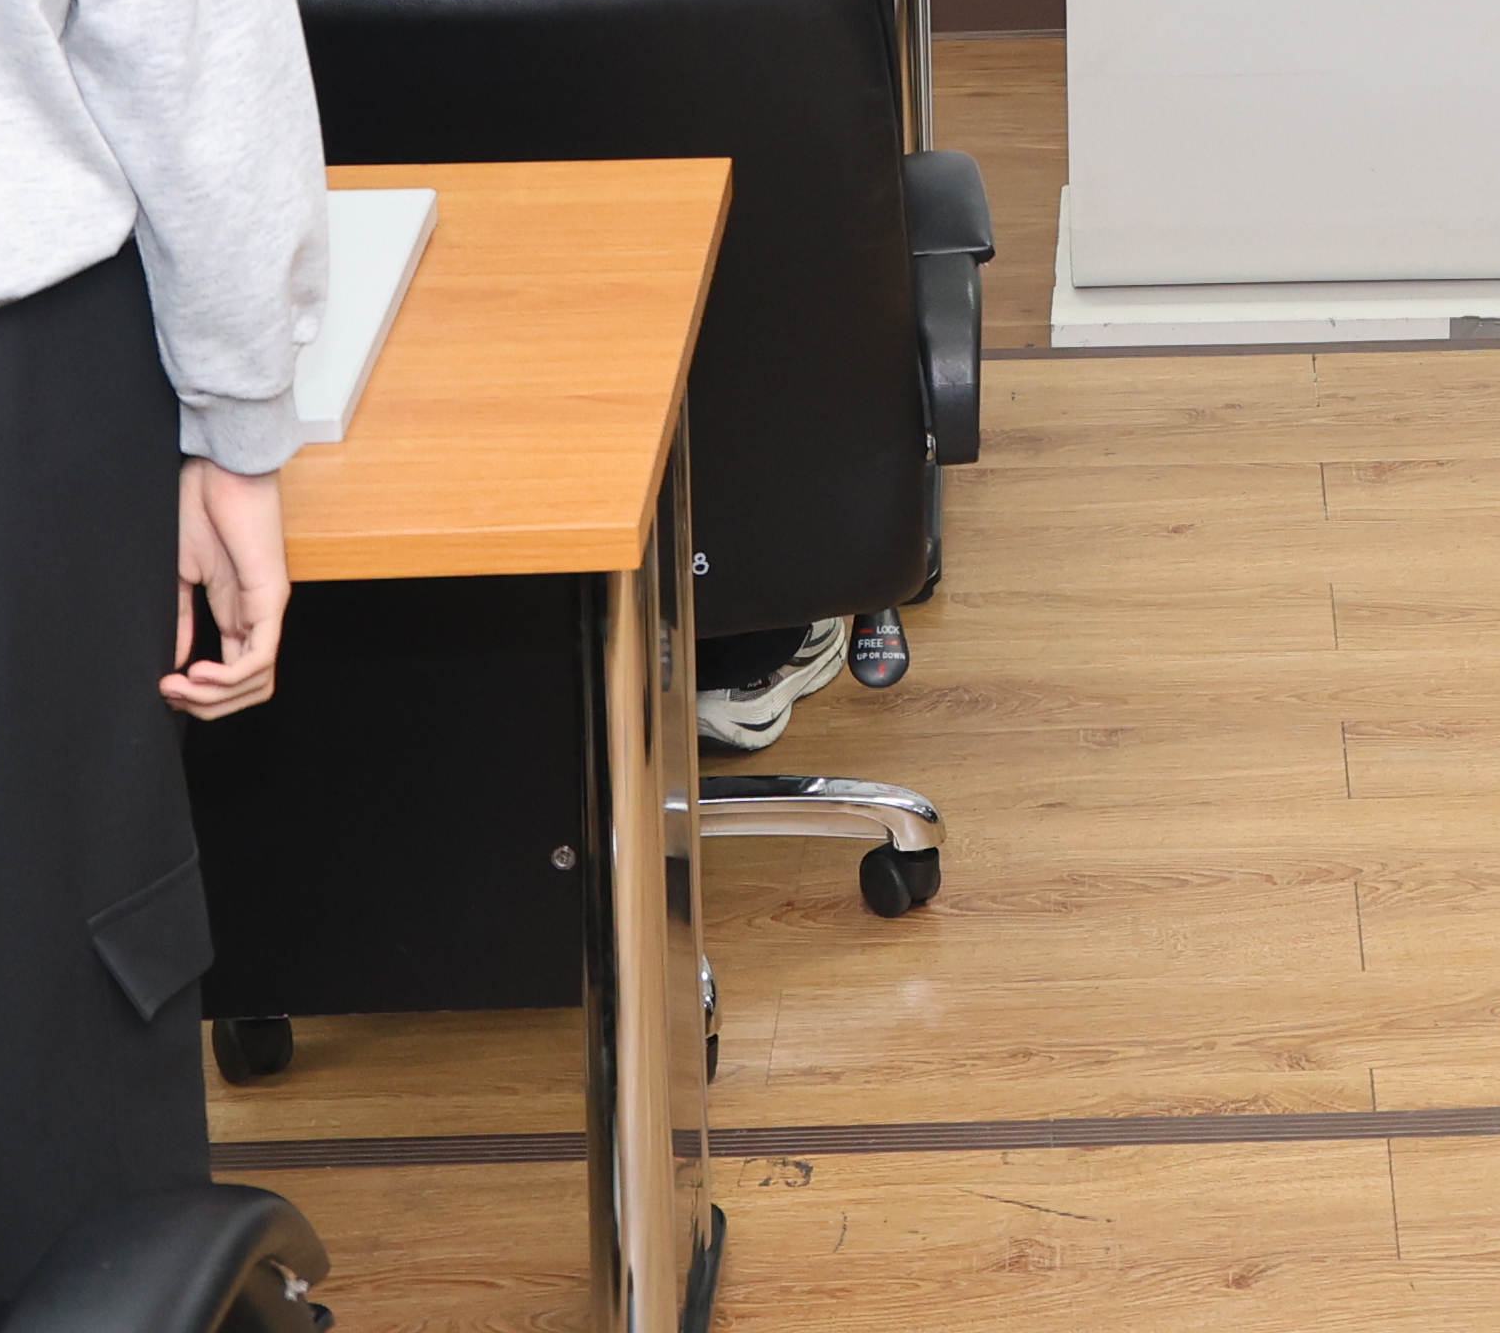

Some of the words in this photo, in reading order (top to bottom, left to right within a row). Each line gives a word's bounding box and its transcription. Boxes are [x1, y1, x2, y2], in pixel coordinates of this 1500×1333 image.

[876, 625, 900, 635] LOCK
[858, 638, 884, 649] FREE
[857, 653, 868, 661] UP
[869, 652, 880, 660] OR
[882, 652, 906, 660] DOWN
